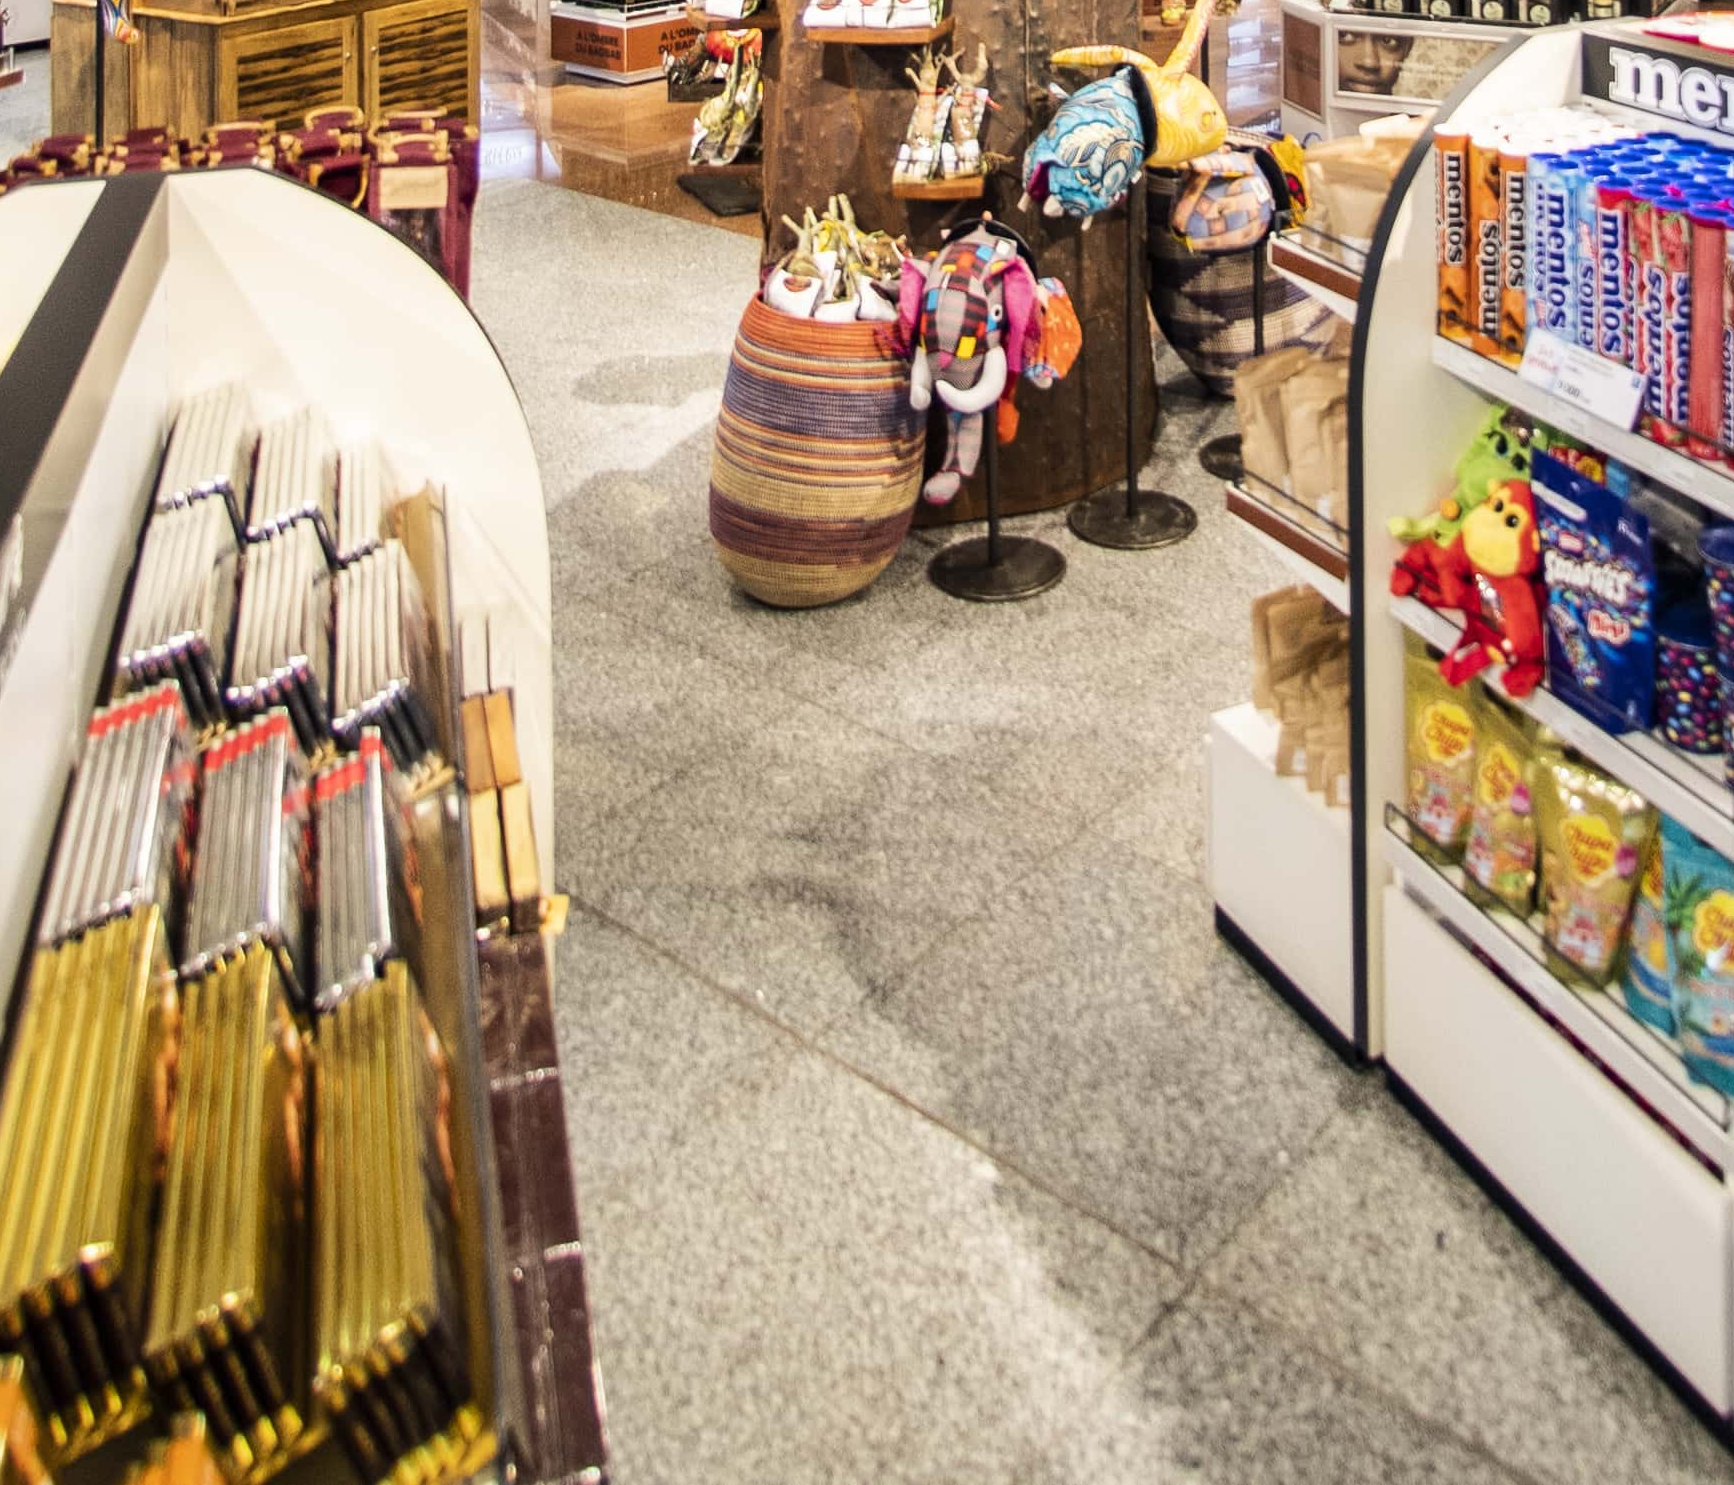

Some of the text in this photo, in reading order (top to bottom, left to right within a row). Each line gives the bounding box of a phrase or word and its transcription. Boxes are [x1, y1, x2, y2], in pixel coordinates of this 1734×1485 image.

[1447, 154, 1464, 263] mentos
[1508, 174, 1526, 289] mentos
[1547, 193, 1566, 329] mentos
[1480, 222, 1499, 338] mentos
[1601, 213, 1620, 355] mentos
